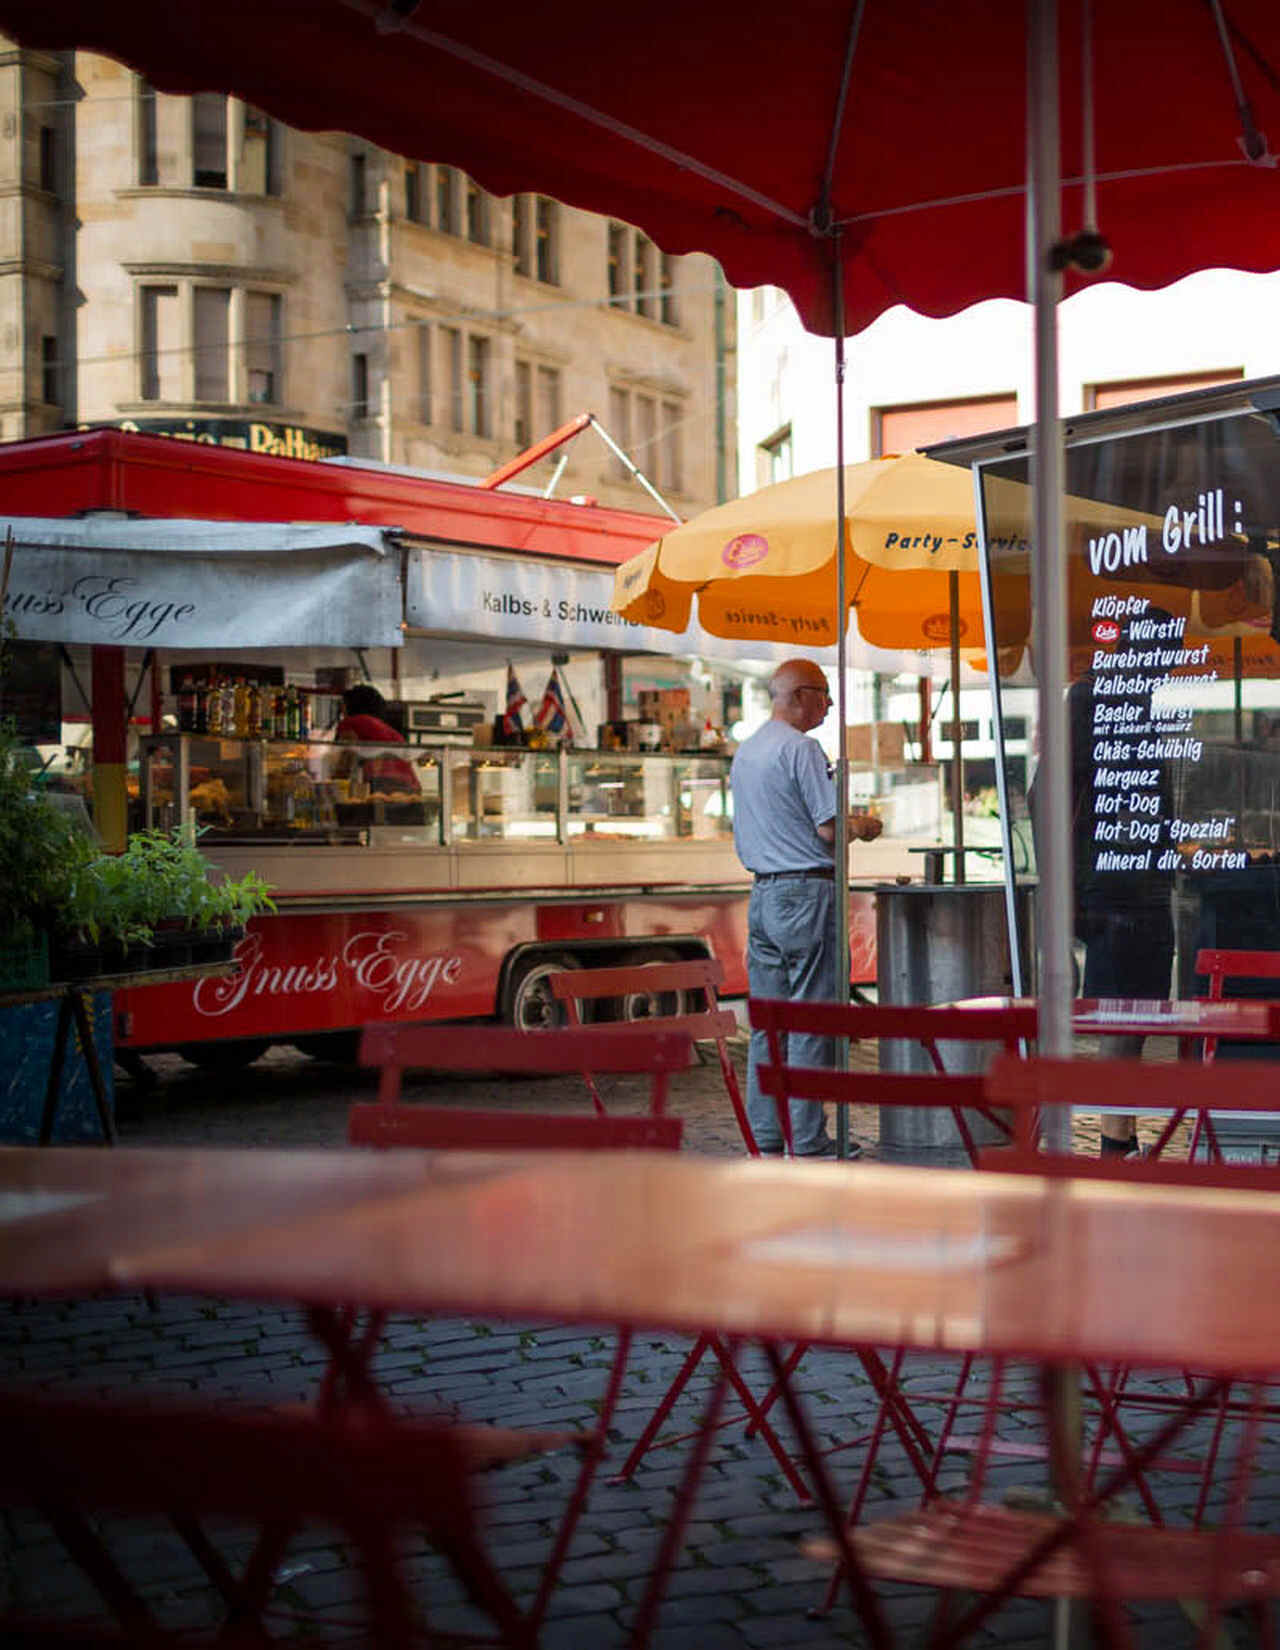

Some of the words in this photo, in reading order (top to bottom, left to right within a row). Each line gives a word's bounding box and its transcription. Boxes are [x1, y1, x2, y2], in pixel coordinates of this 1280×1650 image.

[71, 575, 196, 640] Egge
[1092, 596, 1150, 620] Klöpfer
[1092, 644, 1211, 670] Burebratwurst
[1094, 702, 1144, 723] Basler
[1093, 738, 1203, 762] Chäs-Schüblig
[1094, 768, 1161, 790] Merguez
[1094, 793, 1161, 815] Hot-Dog
[1094, 820, 1161, 843] Hot-Dog
[1095, 850, 1151, 871] Mineral
[1157, 850, 1186, 870] div.
[1192, 849, 1247, 870] Sorten
[342, 931, 462, 1012] Egge
